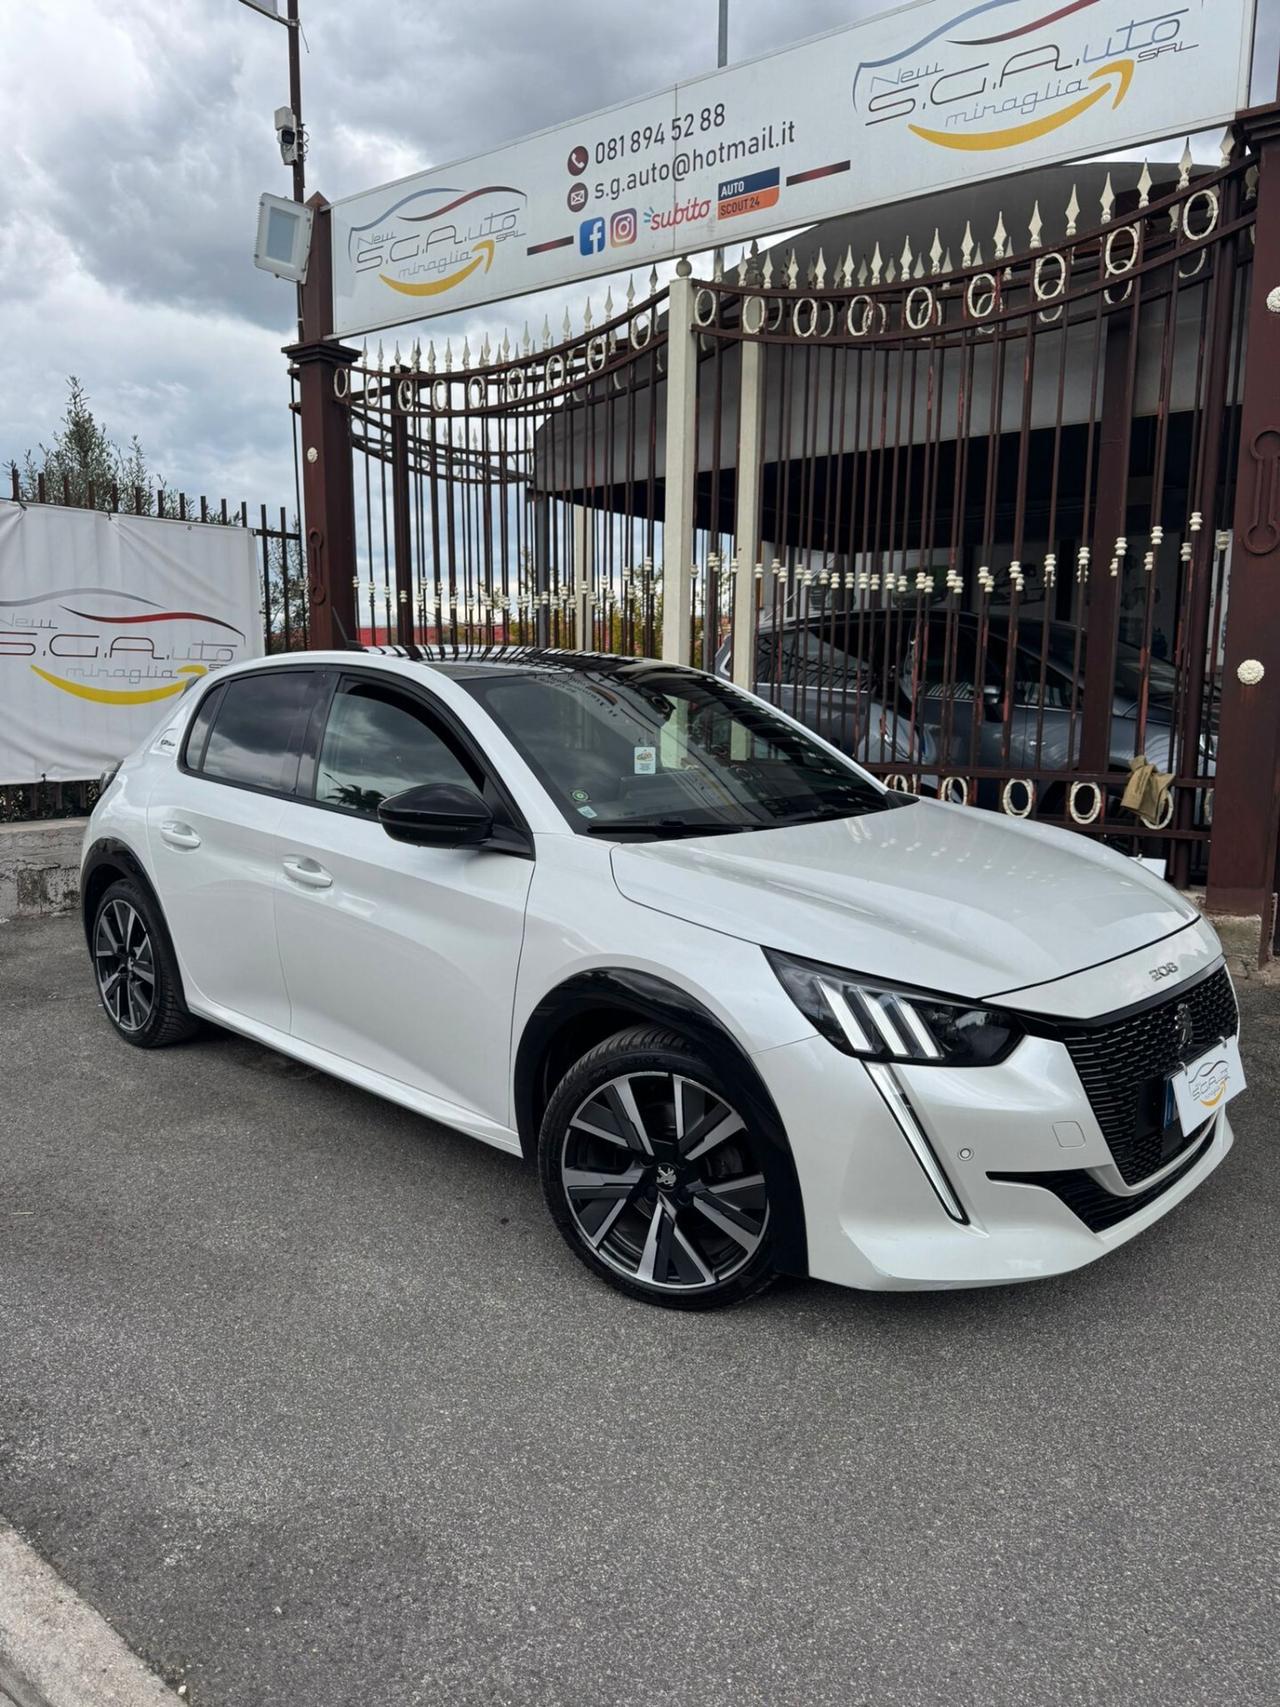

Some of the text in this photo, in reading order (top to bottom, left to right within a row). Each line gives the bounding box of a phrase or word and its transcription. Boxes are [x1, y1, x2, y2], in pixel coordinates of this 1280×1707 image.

[870, 62, 944, 93] New
[945, 76, 1089, 127] miraglia
[595, 103, 725, 165] 081 894 52 88
[594, 120, 796, 200] s.g.auto@hotmail.it
[720, 181, 745, 198] AUTO
[650, 197, 712, 231] subito
[720, 196, 760, 216] SCOUT 24
[357, 231, 396, 250] New
[399, 250, 472, 277] miraglia
[66, 663, 178, 685] miraglia
[1149, 961, 1178, 982] 208
